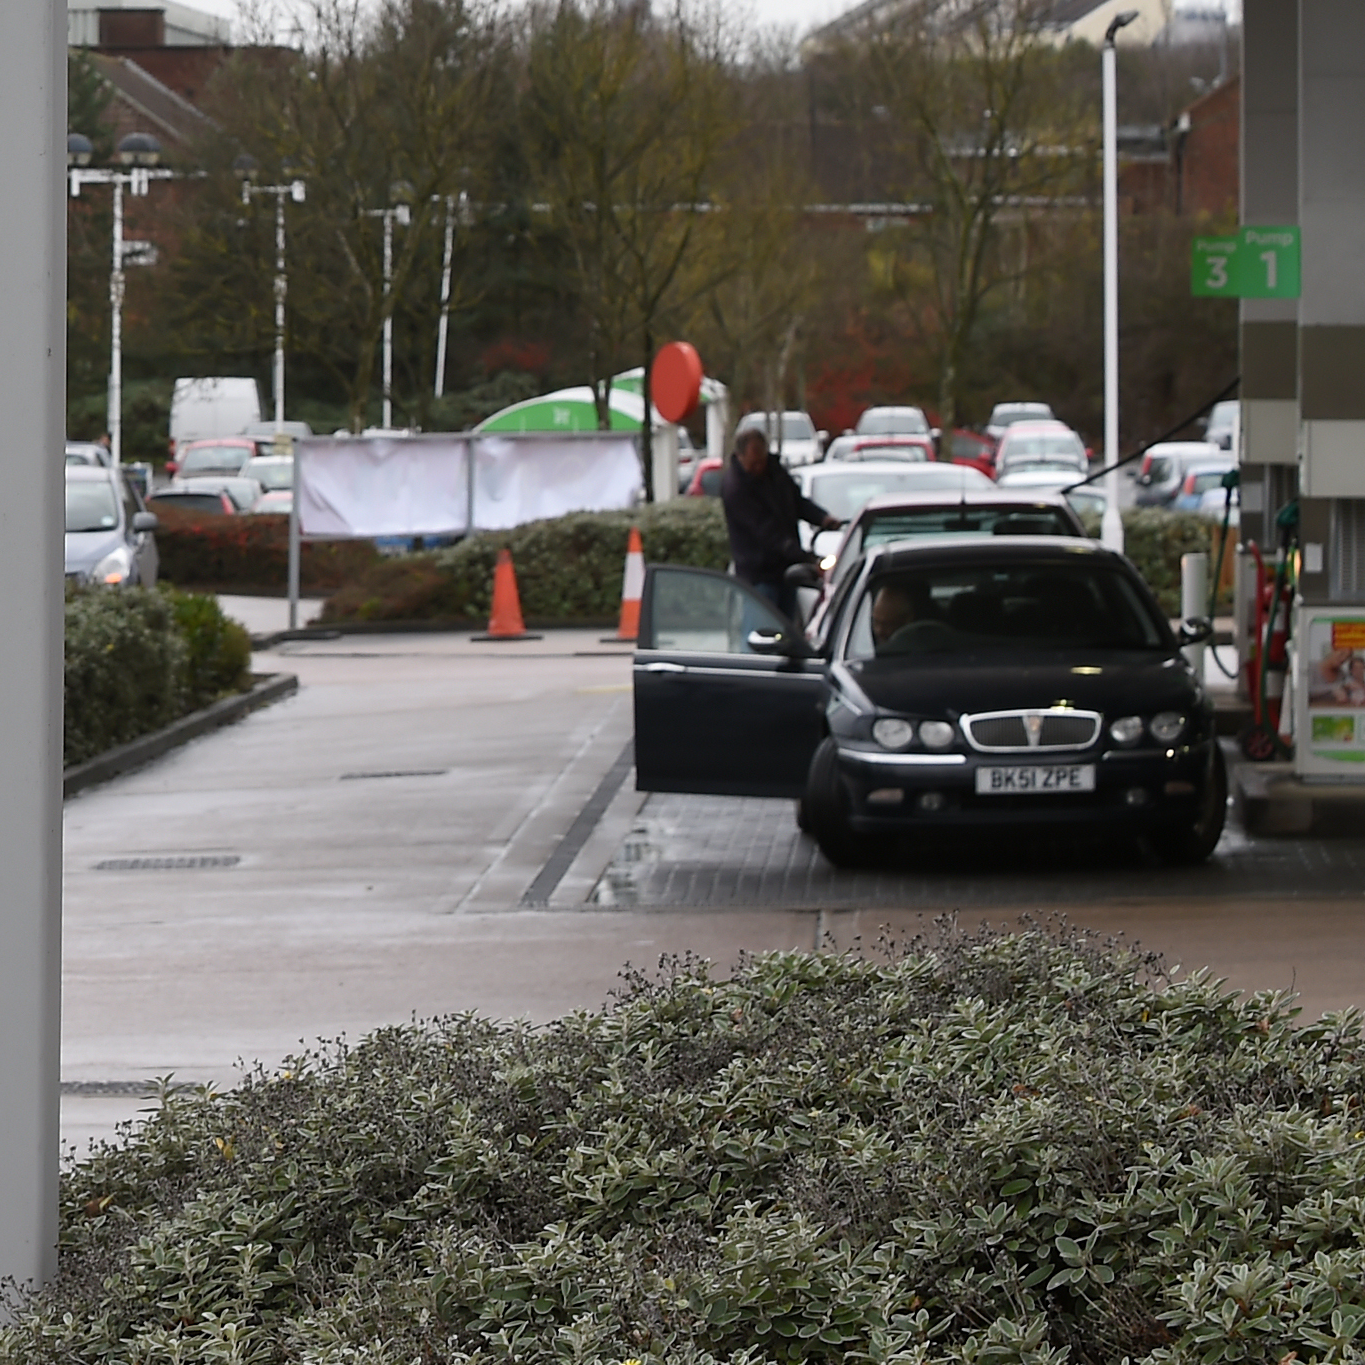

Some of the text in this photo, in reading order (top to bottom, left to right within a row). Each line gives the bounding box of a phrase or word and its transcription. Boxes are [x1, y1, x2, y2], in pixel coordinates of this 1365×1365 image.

[1205, 256, 1227, 288] 3
[1260, 250, 1277, 289] 1
[1043, 766, 1081, 787] ZPE
